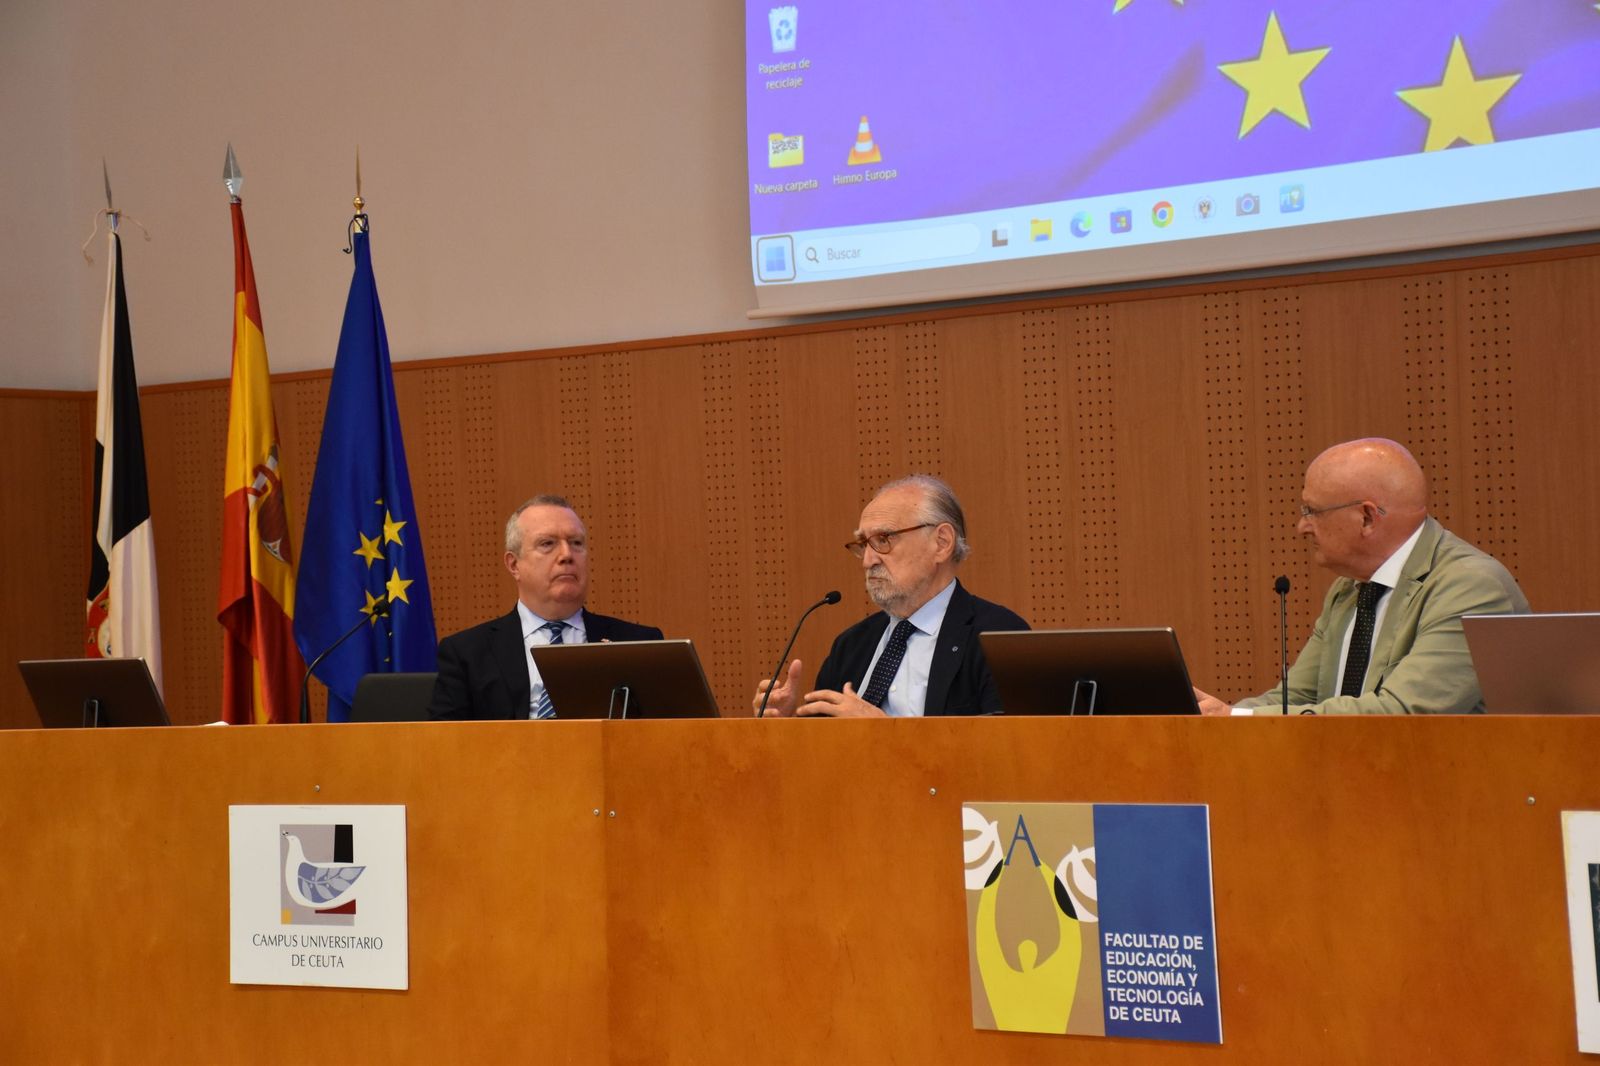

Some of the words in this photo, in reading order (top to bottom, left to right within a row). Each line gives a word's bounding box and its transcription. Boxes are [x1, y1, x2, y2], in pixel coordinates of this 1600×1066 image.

[758, 61, 797, 75] Papelera
[799, 57, 811, 70] de
[766, 76, 803, 91] reciclaje
[832, 172, 863, 186] Himno
[865, 169, 897, 182] Europa
[754, 182, 784, 195] Nueva
[785, 179, 819, 192] carpeta
[826, 246, 862, 262] Buscar
[252, 933, 298, 948] CAMPUS
[301, 935, 383, 950] UNIVERSITARIO
[1104, 932, 1179, 950] FACULTAD
[1183, 935, 1204, 950] DE
[291, 954, 306, 967] DE
[308, 954, 344, 968] CEUTA
[1106, 950, 1197, 971] EDUCACIÓN,
[1107, 969, 1186, 987] ECONOMÍA
[1188, 972, 1198, 987] Y
[1107, 987, 1204, 1006] TECNOLOGÍA
[1109, 1005, 1130, 1021] DE
[1132, 1006, 1182, 1024] CEUTA
